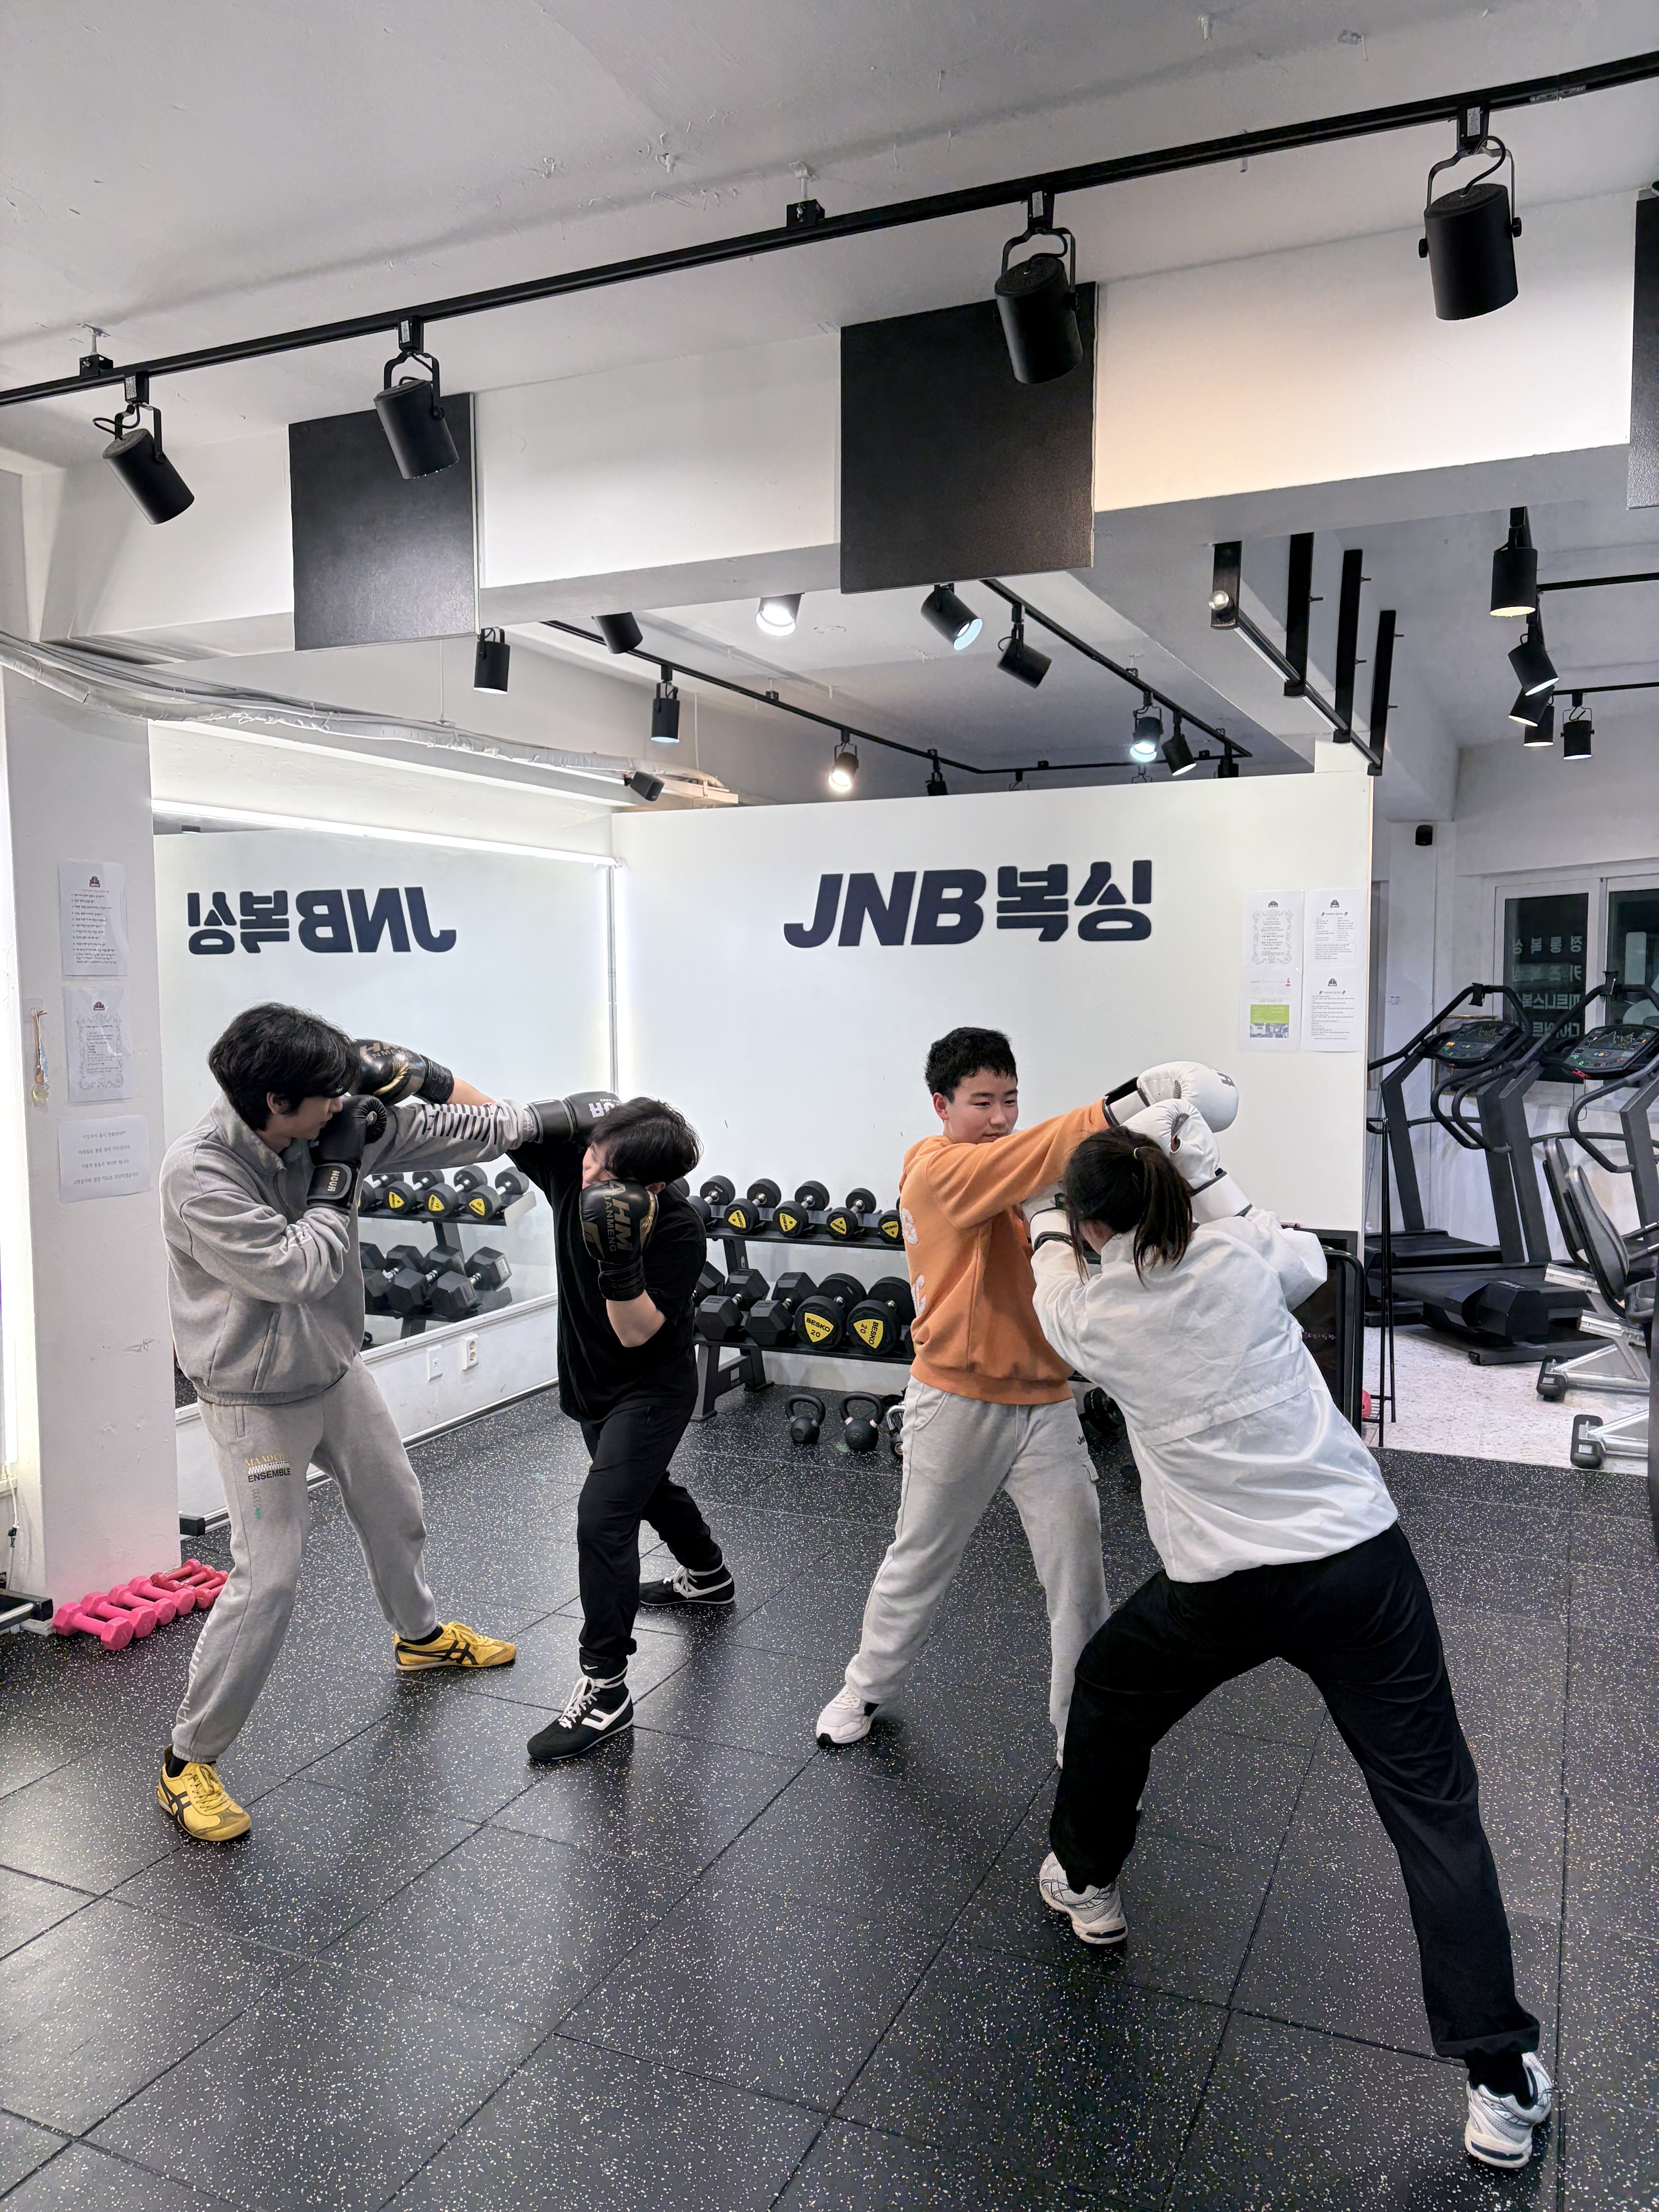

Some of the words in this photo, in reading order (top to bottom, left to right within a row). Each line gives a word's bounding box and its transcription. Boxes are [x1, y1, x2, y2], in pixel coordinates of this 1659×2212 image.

[783, 860, 1152, 948] JNB복싱
[806, 1317, 830, 1332] BESKO
[860, 1323, 867, 1334] 20
[811, 1329, 820, 1338] 20
[868, 1321, 879, 1345] BESKO
[248, 1468, 291, 1483] ENSEMBLE
